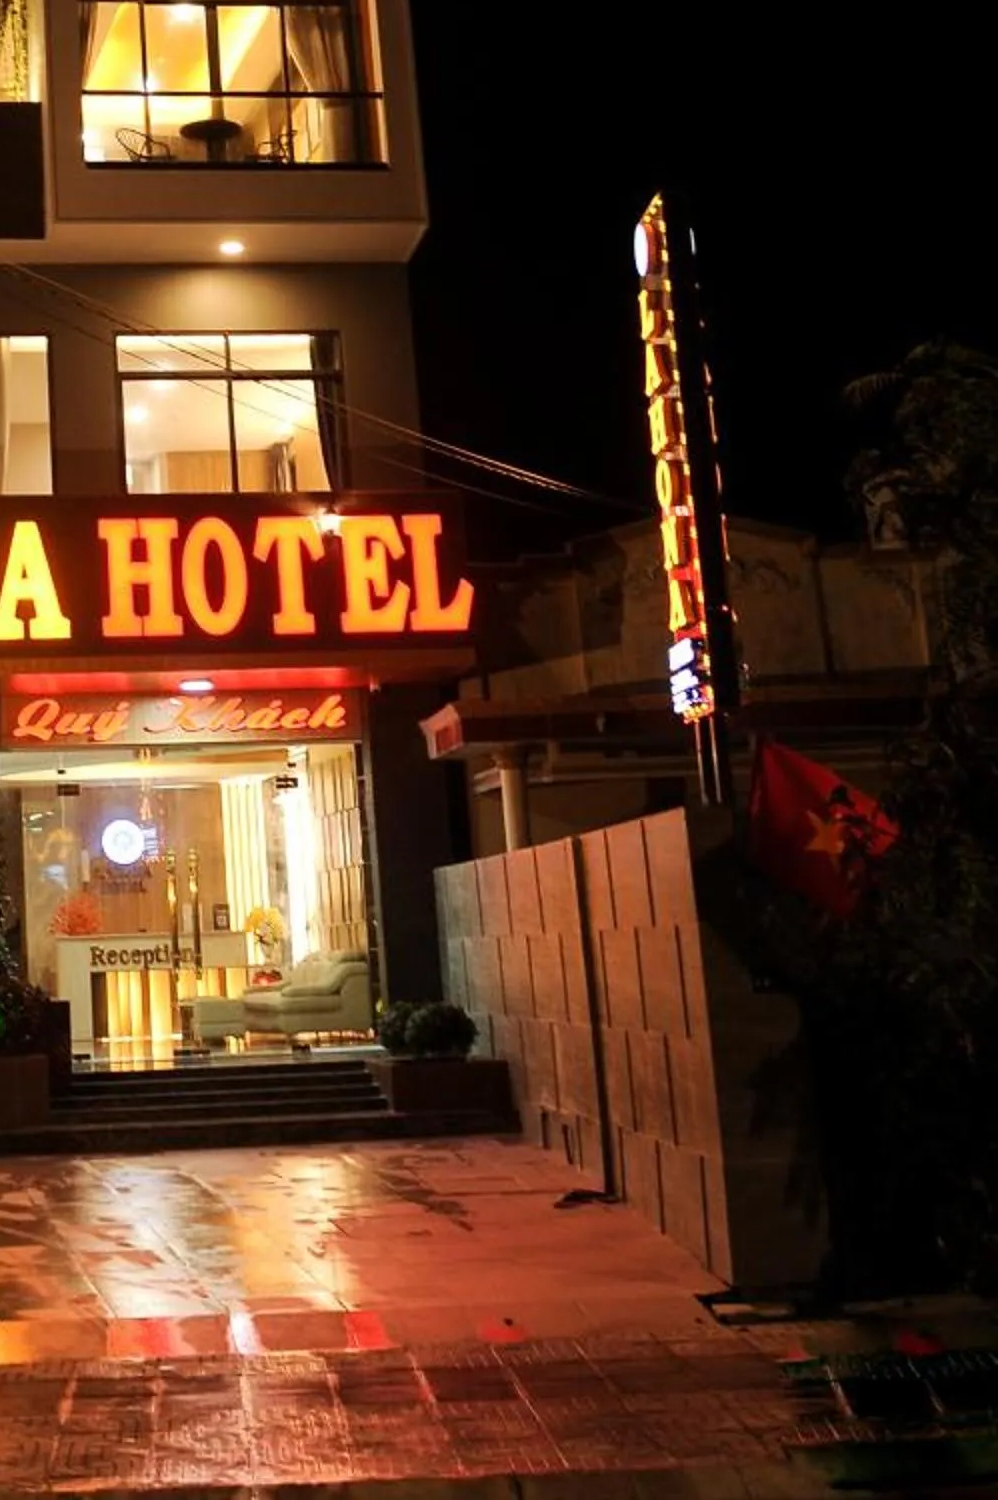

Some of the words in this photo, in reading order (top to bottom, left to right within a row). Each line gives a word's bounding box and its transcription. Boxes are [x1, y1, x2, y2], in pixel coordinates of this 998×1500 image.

[98, 514, 474, 637] HOTEL
[13, 699, 130, 742] Quý
[143, 694, 346, 733] Khách
